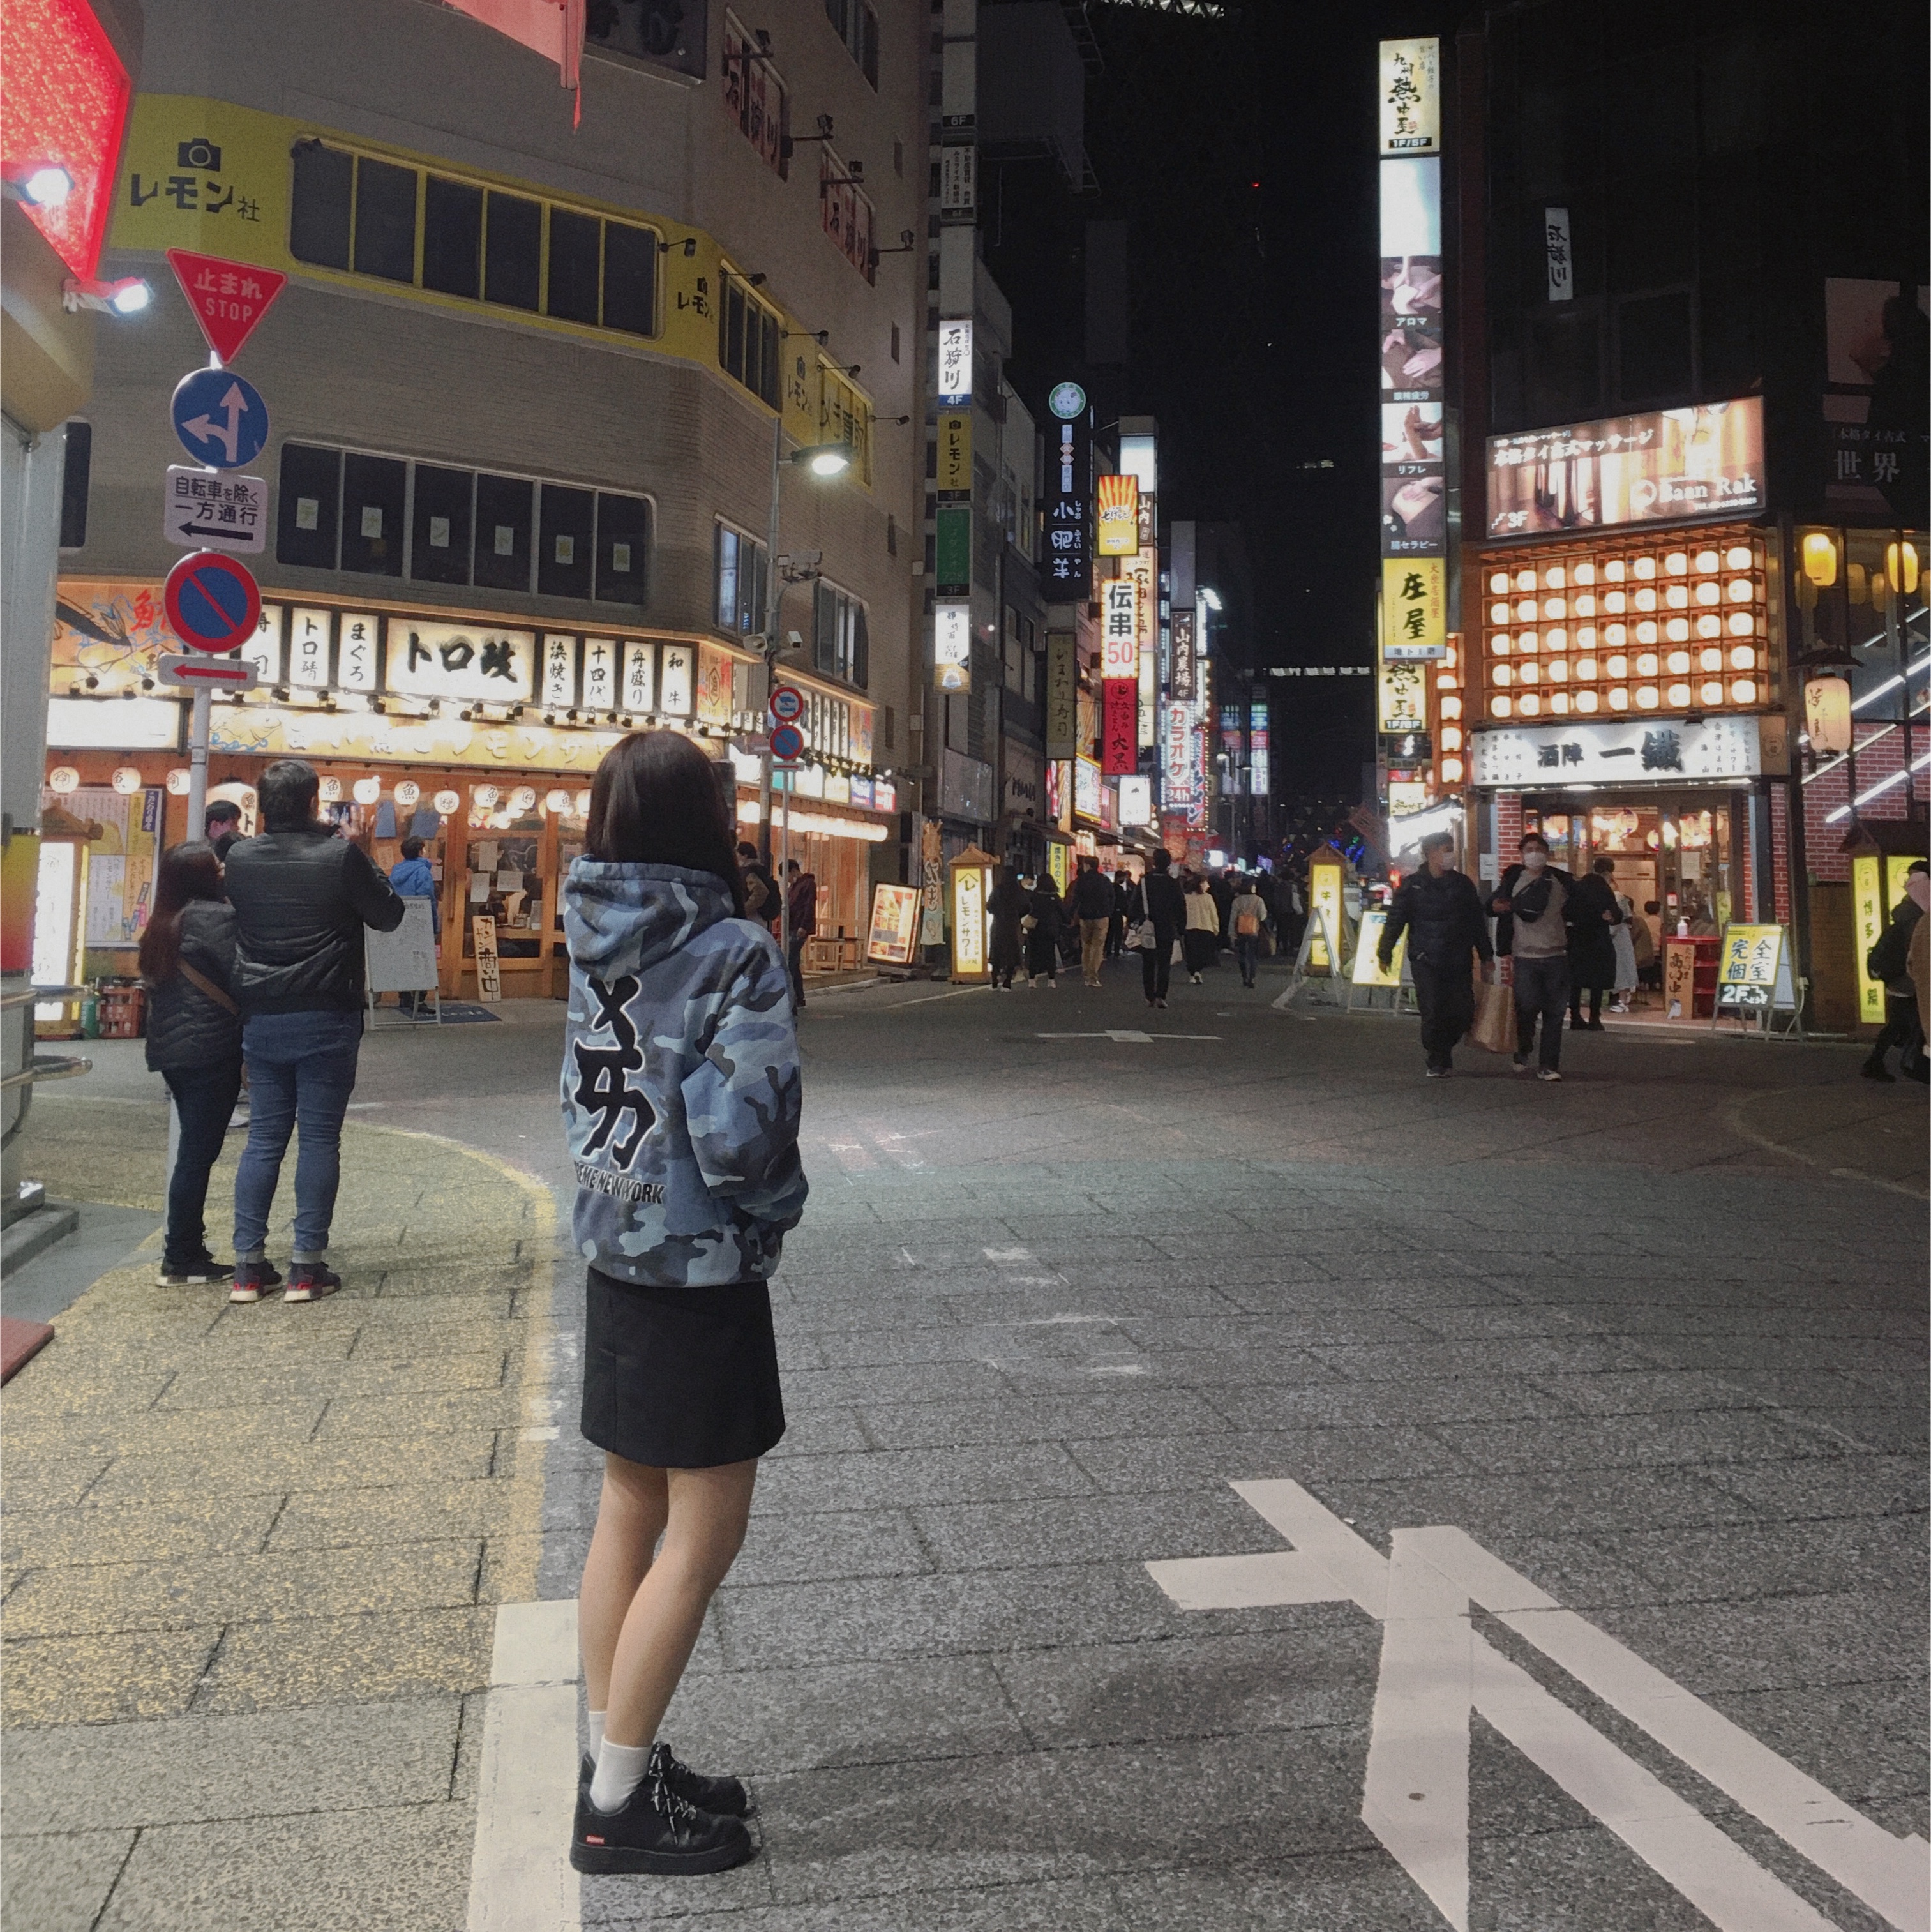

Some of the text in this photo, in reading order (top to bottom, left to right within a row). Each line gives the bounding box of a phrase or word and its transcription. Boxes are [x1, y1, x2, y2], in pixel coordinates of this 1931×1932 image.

[950, 116, 966, 126] 6F
[1393, 138, 1427, 147] 1F/5F
[131, 174, 260, 222] レモン社
[194, 268, 263, 299] 止まれ
[206, 297, 252, 322] STOP
[1395, 317, 1428, 327] アロマ
[943, 329, 963, 390] 石狩川
[947, 395, 963, 405] 4F
[1399, 465, 1427, 474] リフレ
[1716, 472, 1757, 496] Rak
[176, 476, 258, 504] 自転車を除く
[175, 501, 258, 525] 一方通行
[1508, 511, 1529, 528] 3F
[1051, 501, 1074, 579] 小肥羊
[1109, 585, 1132, 637] 伝串
[1400, 572, 1428, 639] 庄屋
[301, 617, 319, 681] トロ鯖
[350, 622, 367, 682] まぐろ
[1108, 642, 1133, 664] 50
[1175, 628, 1191, 687] 山内農場
[550, 641, 567, 698] 浜焼き
[590, 645, 606, 702] 十四代
[630, 649, 646, 704] 舟盛り
[668, 652, 684, 706] 和牛
[1169, 708, 1185, 777] カラオケ
[403, 783, 415, 796] 魚
[1167, 789, 1190, 802] 24h
[961, 896, 971, 956] レモンサワー
[1731, 939, 1771, 960] 完全
[1726, 961, 1769, 981] 個室
[1722, 985, 1750, 1003] 2F
[596, 1171, 624, 1196] NEW
[622, 1180, 665, 1204] YORK
